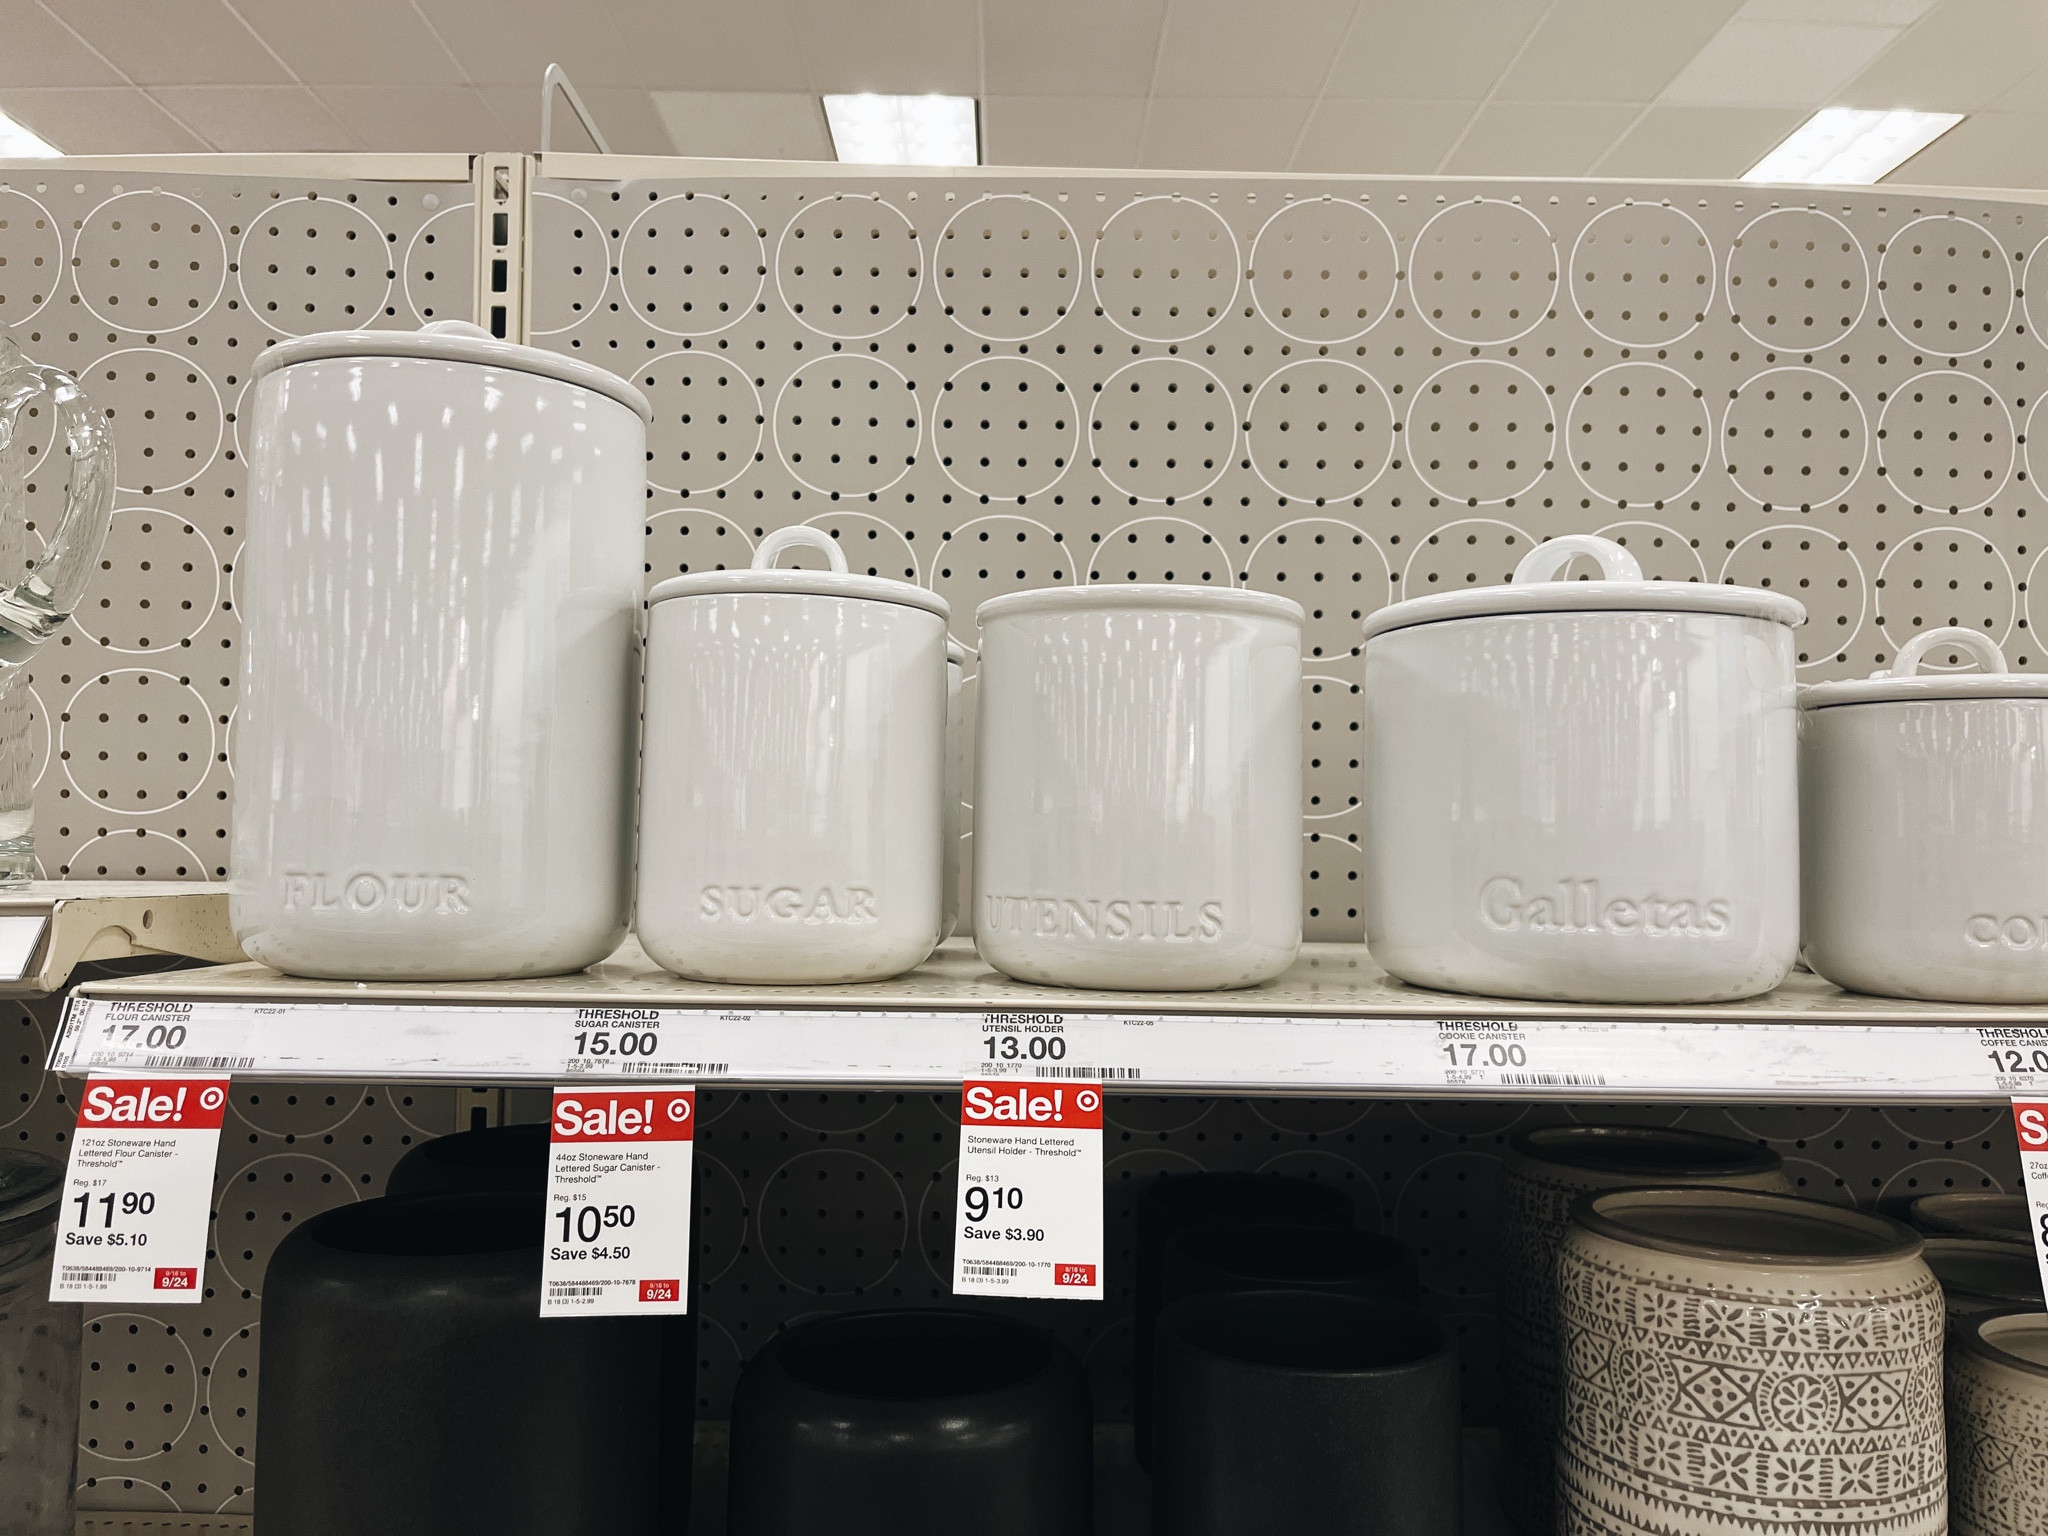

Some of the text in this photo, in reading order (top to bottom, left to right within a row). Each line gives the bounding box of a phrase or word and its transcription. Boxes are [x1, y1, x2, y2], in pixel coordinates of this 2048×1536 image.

[284, 872, 470, 914] FLOUR
[700, 885, 878, 925] SUGAR
[1479, 873, 1732, 938] Galletas
[986, 896, 1223, 943] UTENSILS
[110, 1002, 193, 1013] THRESHOLD
[105, 1013, 190, 1022] FLOUR CANISTER
[578, 1009, 660, 1020] THRESHOLD
[982, 1014, 1063, 1024] THRESHOLD
[575, 1020, 660, 1029] SUGAR CANISTER
[982, 1025, 1064, 1033] UTENSIL HOLDER
[1437, 1021, 1518, 1032] THRESHOLD
[103, 1024, 187, 1050] 17.00
[1438, 1032, 1526, 1041] COOKIE CANISTER
[574, 1031, 658, 1056] 15.00
[983, 1036, 1066, 1060] 13.00
[1981, 1039, 2017, 1047] COFFEE
[1443, 1043, 1527, 1067] 17.00
[83, 1086, 188, 1122] Sale!
[965, 1086, 1063, 1122] Sale!
[554, 1099, 654, 1136] Sale!
[81, 1139, 176, 1147] 121oz Stoneware Hand
[967, 1136, 1075, 1146] Stoneware Hand Lettered
[78, 1149, 113, 1157] Lettered
[138, 1150, 173, 1158] Canister
[967, 1146, 997, 1154] Utensil
[998, 1147, 1026, 1155] Holder
[556, 1152, 649, 1161] 44oz Stoneware Hand
[555, 1164, 590, 1173] Lettered
[592, 1164, 618, 1174] Sugar
[619, 1163, 655, 1172] Canister
[966, 1174, 983, 1183] Reg.
[2031, 1172, 2048, 1180] Coff
[73, 1179, 107, 1188] Reg. $17
[553, 1194, 571, 1202] Reg.
[65, 1233, 147, 1246] Save $5.10
[964, 1226, 1045, 1242] Save $3.90
[550, 1246, 631, 1260] Save $4.50
[162, 1277, 188, 1288] 9/24
[1062, 1273, 1088, 1284] 9/24
[646, 1289, 672, 1300] 9/24
